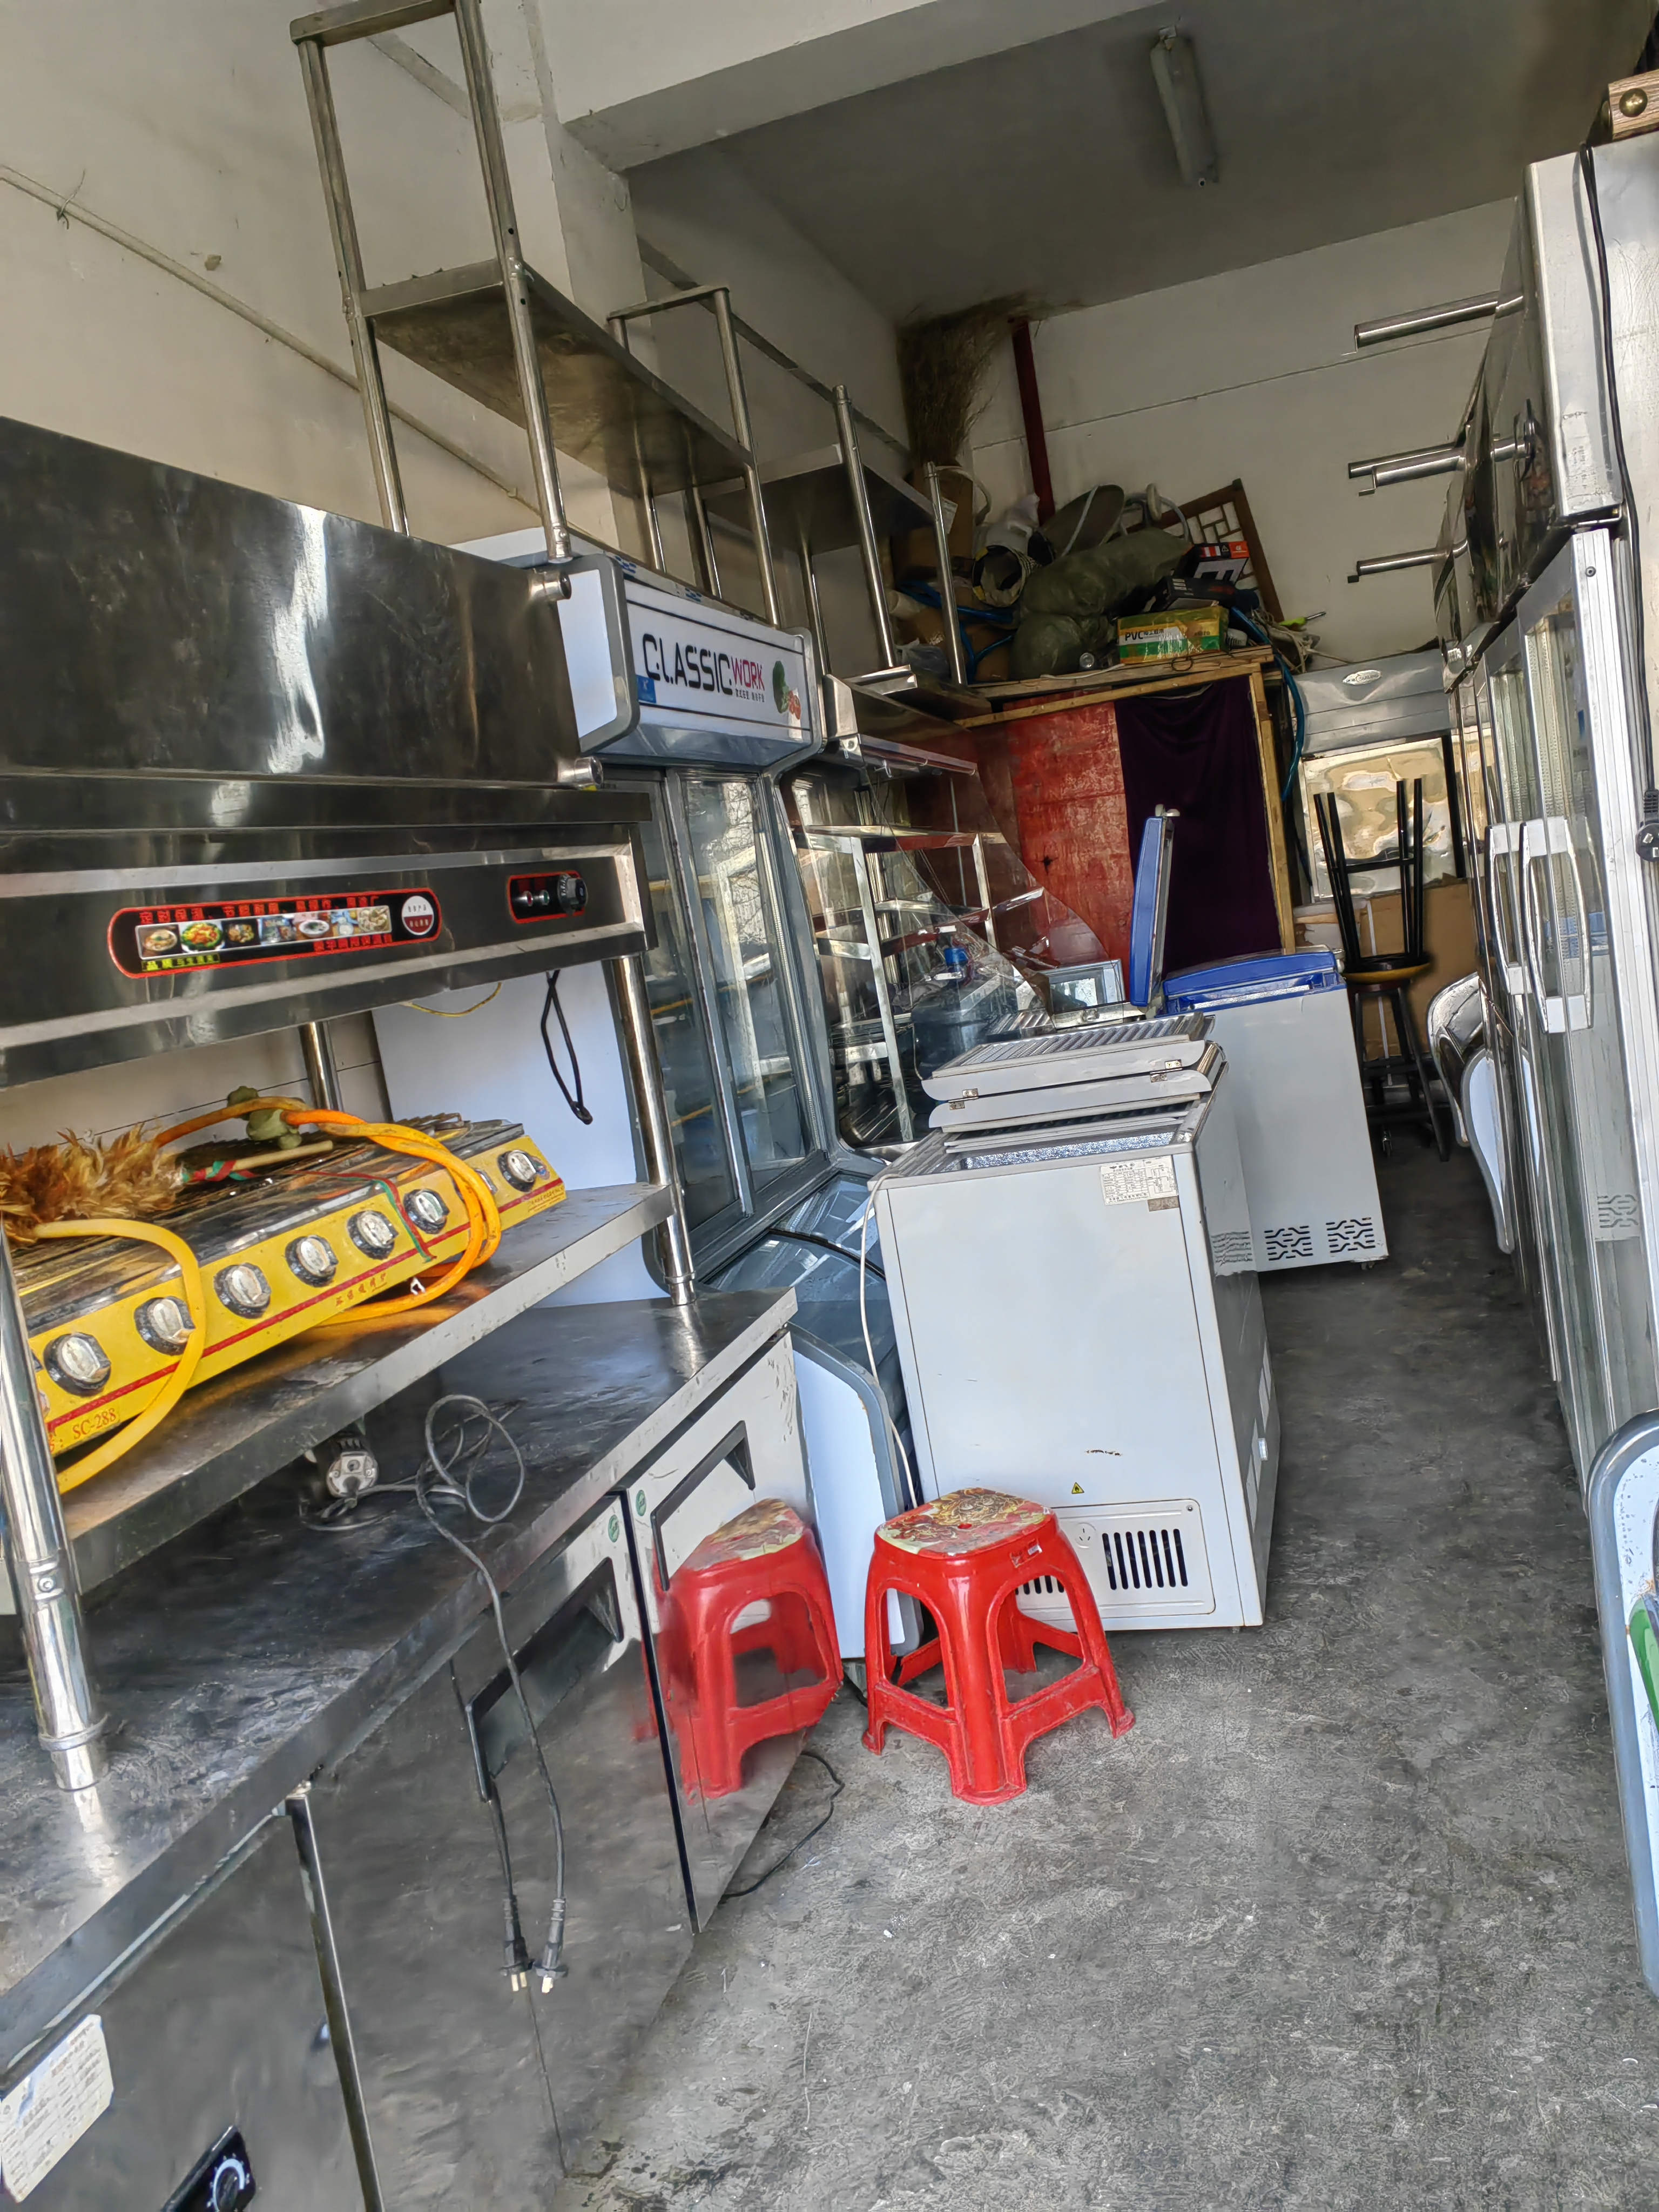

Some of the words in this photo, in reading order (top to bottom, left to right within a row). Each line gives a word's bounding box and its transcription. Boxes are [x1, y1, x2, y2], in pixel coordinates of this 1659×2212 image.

[1125, 631, 1143, 641] PVC
[643, 633, 733, 695] CLASSIC
[731, 656, 765, 691] WORK
[72, 1408, 117, 1440] SC-288
